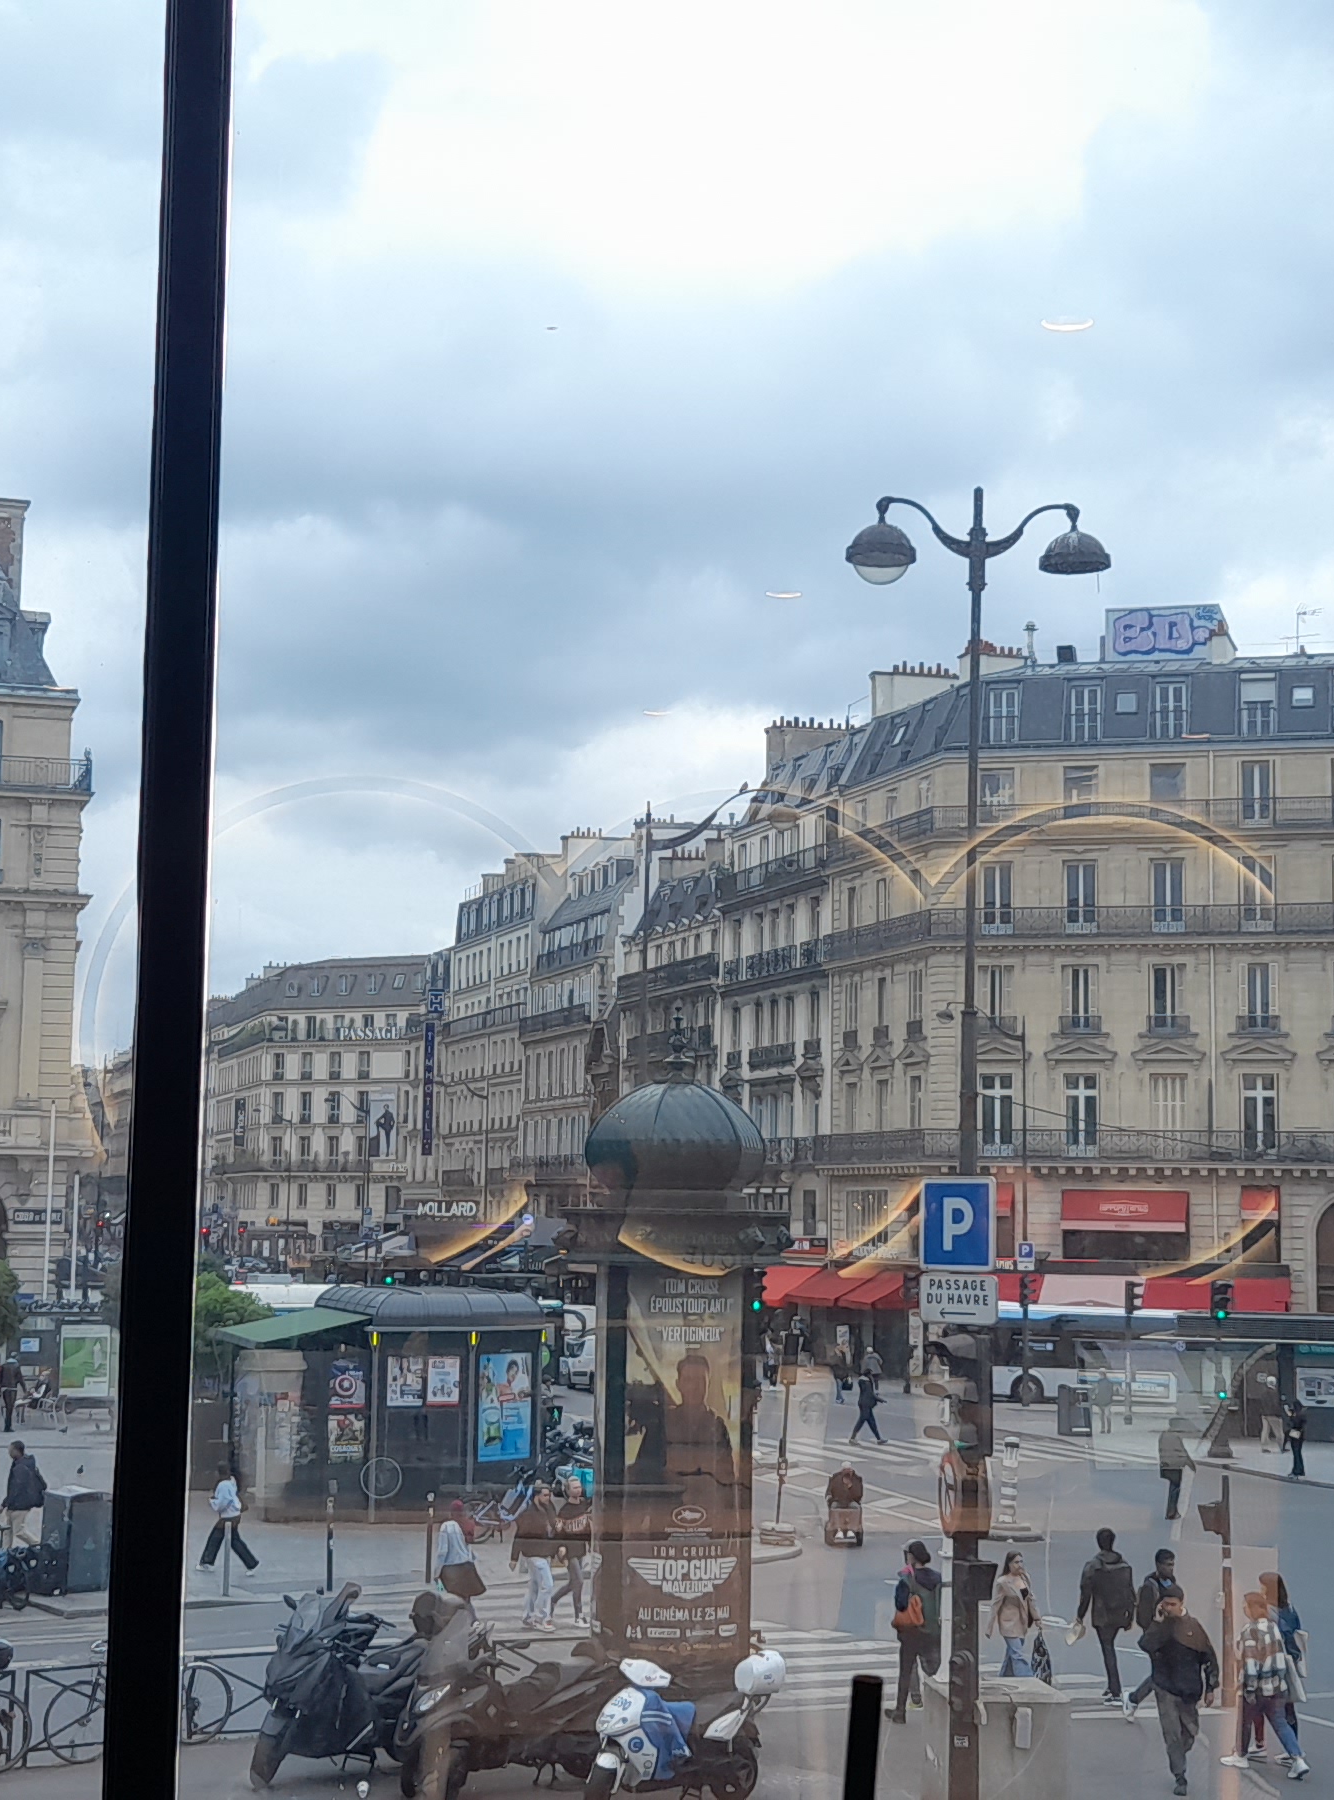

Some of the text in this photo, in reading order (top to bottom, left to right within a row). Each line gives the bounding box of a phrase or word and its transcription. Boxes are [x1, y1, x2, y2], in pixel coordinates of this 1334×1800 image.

[417, 1202, 477, 1216] MOLLARD
[942, 1196, 975, 1251] P
[929, 1278, 987, 1291] PASSAGE
[926, 1293, 989, 1306] DU HAVRE
[653, 1545, 722, 1557] TOM CRUISE
[656, 1559, 722, 1580] TOP GUN
[662, 1580, 715, 1593] MAVERICK
[638, 1607, 652, 1620] AU
[653, 1605, 690, 1621] CINÉMA
[691, 1607, 702, 1620] LE
[704, 1607, 716, 1620] 25
